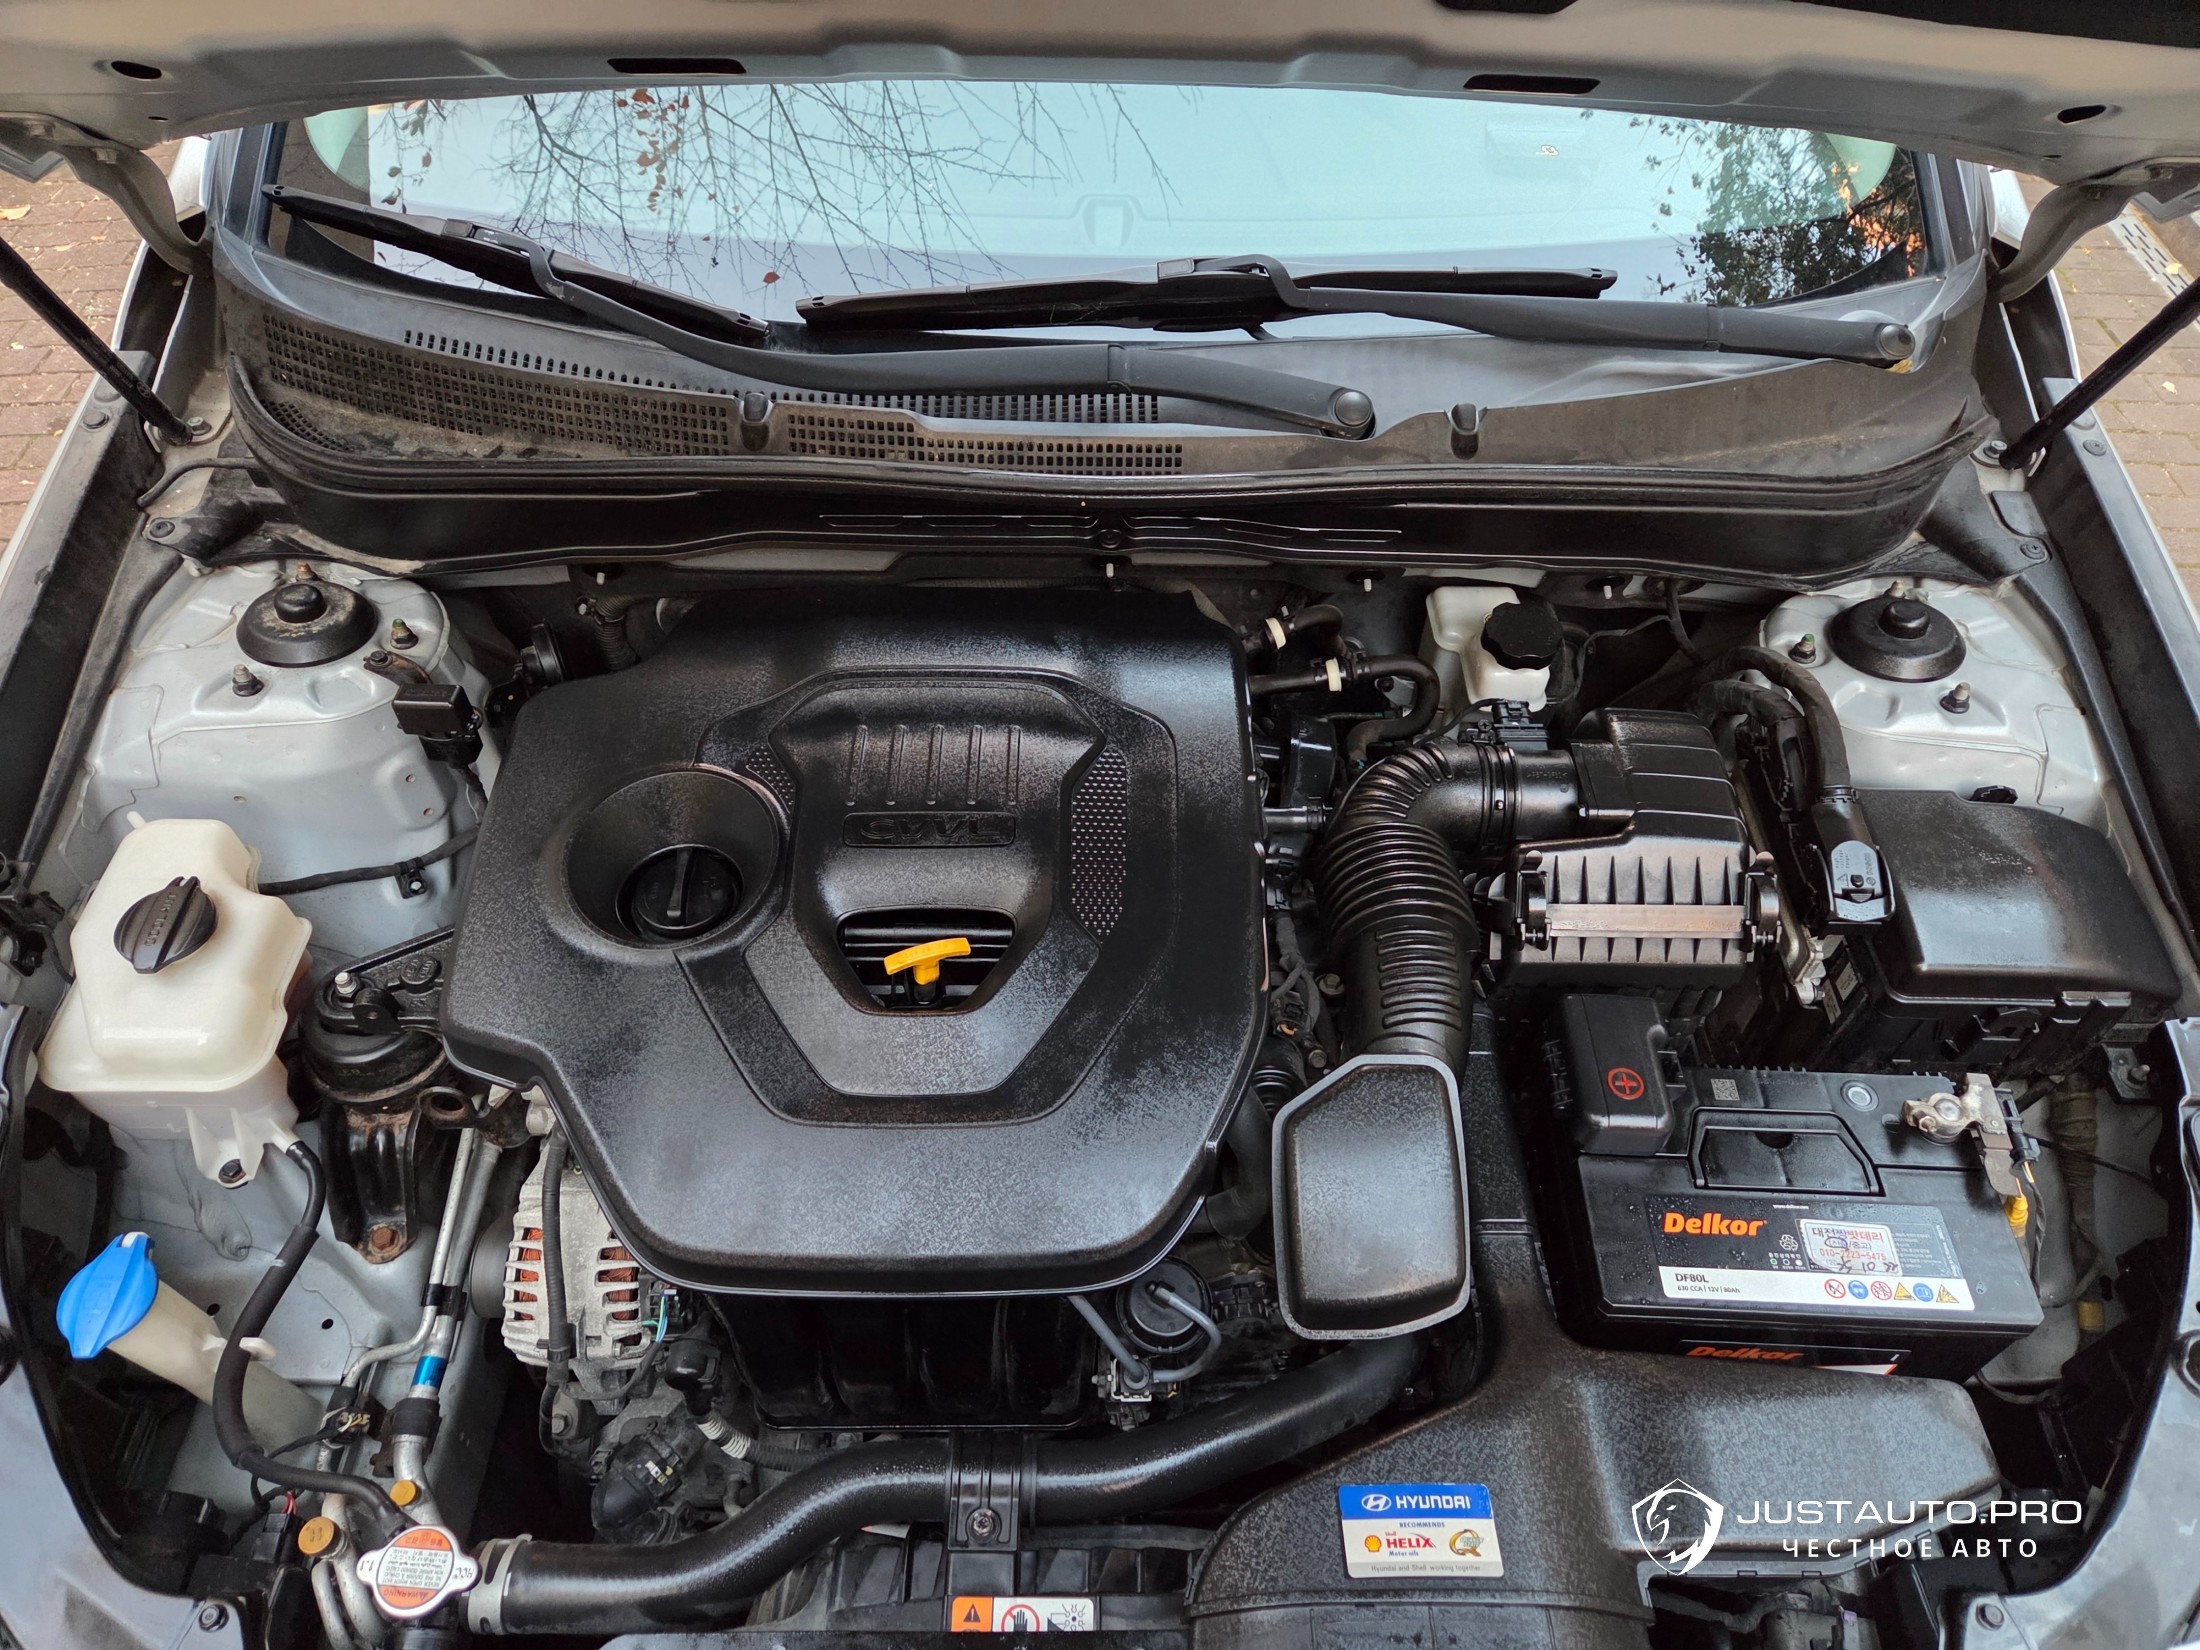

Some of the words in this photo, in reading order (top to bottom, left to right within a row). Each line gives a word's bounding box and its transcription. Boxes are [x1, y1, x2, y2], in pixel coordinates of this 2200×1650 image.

[861, 818, 1002, 839] CVVL
[1664, 1212, 1764, 1236] Delkor
[1675, 1273, 1709, 1283] DF80L
[1686, 1346, 1804, 1360] Delkor
[1396, 1495, 1471, 1509] HYUNDAI
[1386, 1537, 1435, 1549] HELIX
[454, 1567, 475, 1579] HCC
[1371, 1564, 1397, 1572] Hyundai
[1430, 1564, 1454, 1572] working
[1456, 1564, 1481, 1572] together
[383, 1588, 420, 1598] WARNING
